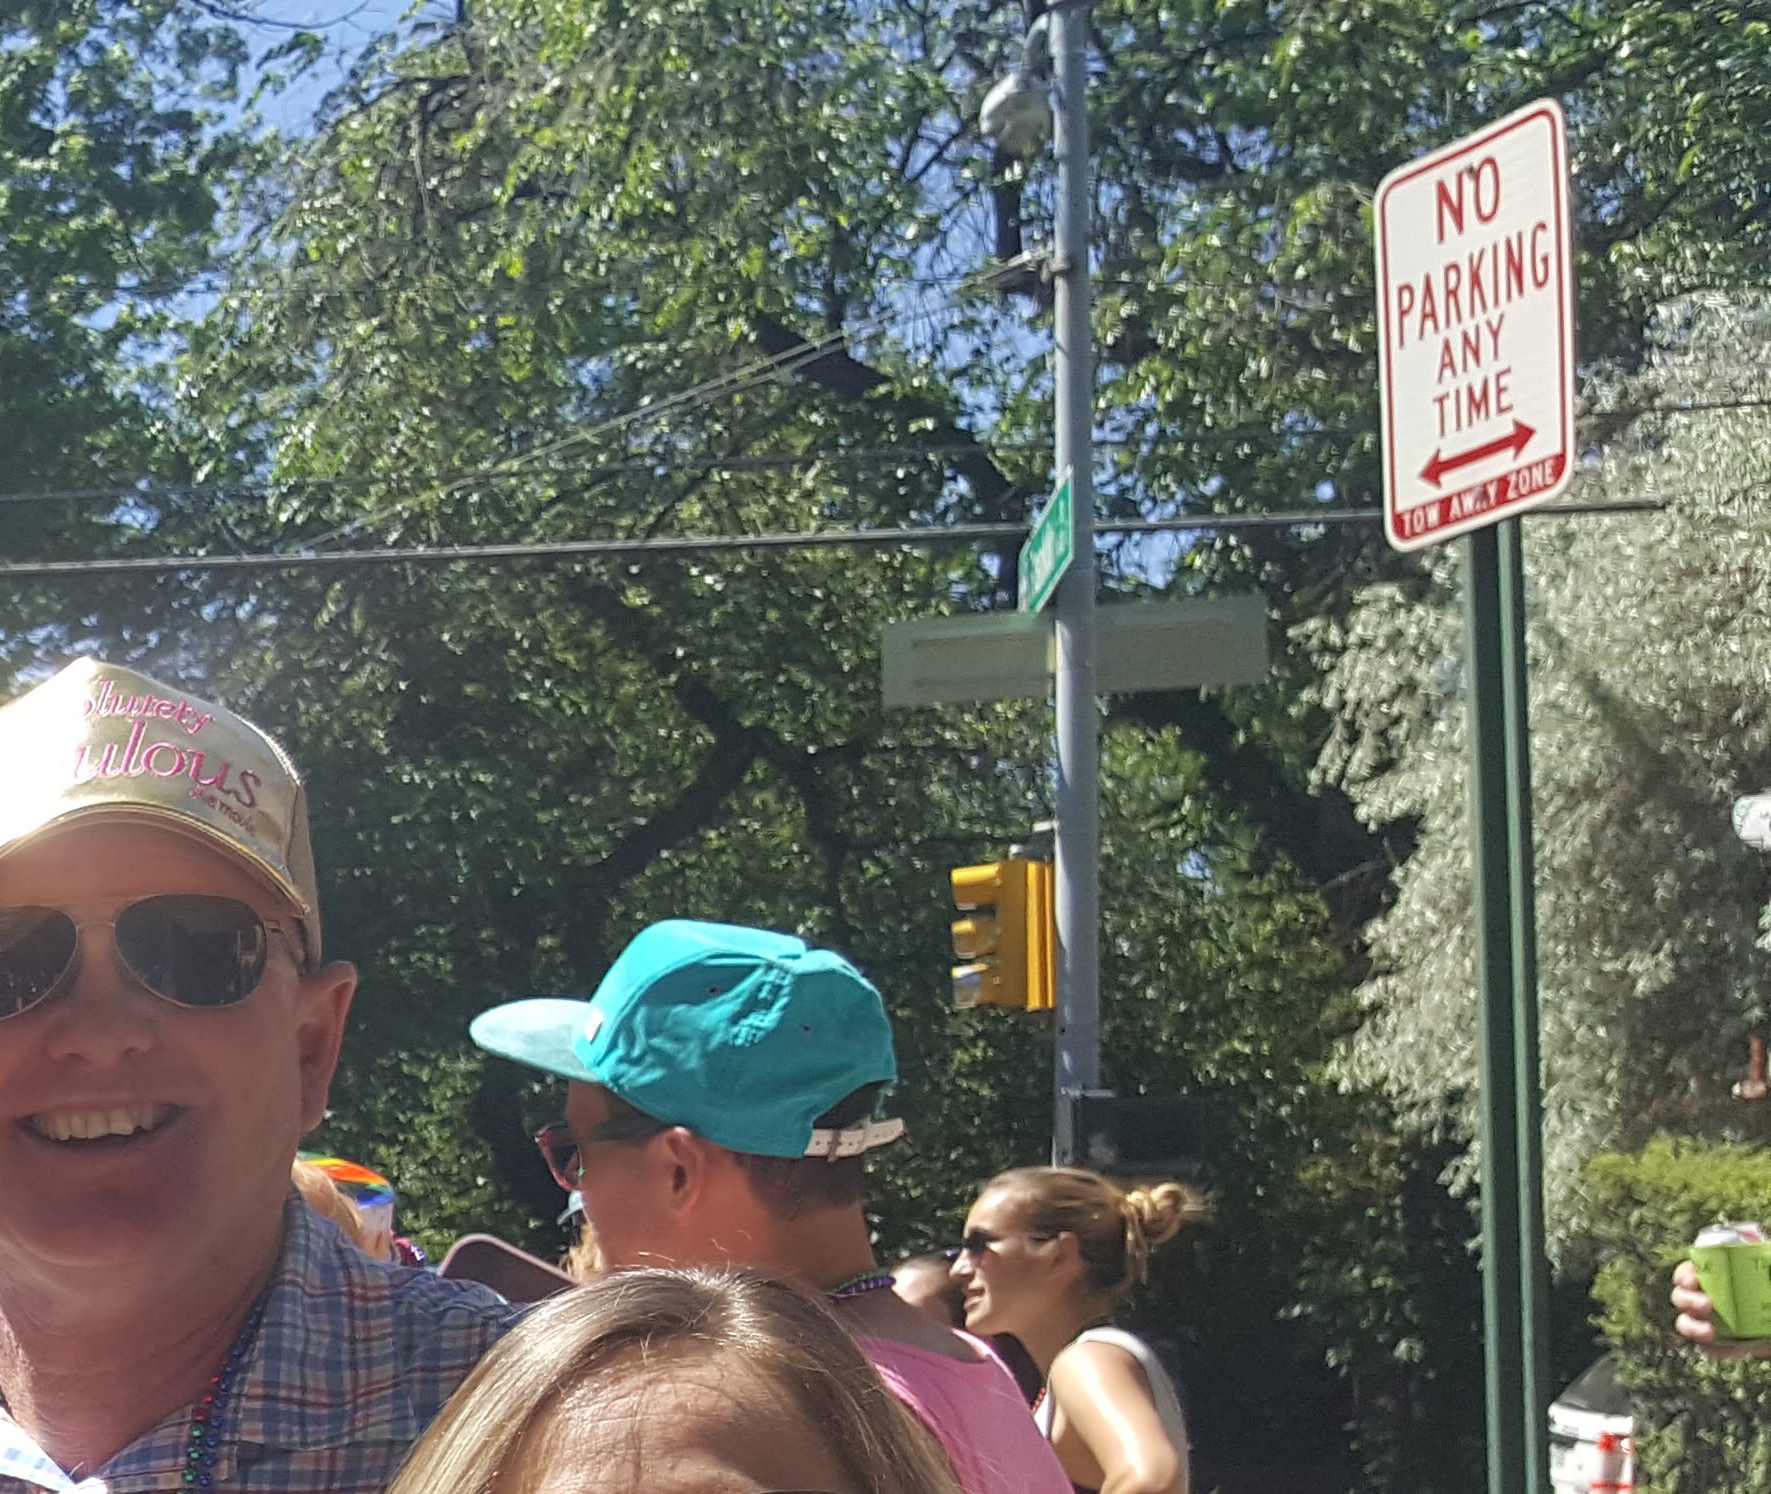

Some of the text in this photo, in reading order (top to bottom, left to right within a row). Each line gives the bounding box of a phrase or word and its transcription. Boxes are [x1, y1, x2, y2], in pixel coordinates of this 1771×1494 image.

[1435, 157, 1501, 244] NO
[1397, 222, 1550, 350] PARKING
[1438, 312, 1505, 384] ANY
[1433, 367, 1514, 438] TIME
[1400, 502, 1441, 538] TOW
[1507, 459, 1556, 499] ZONE
